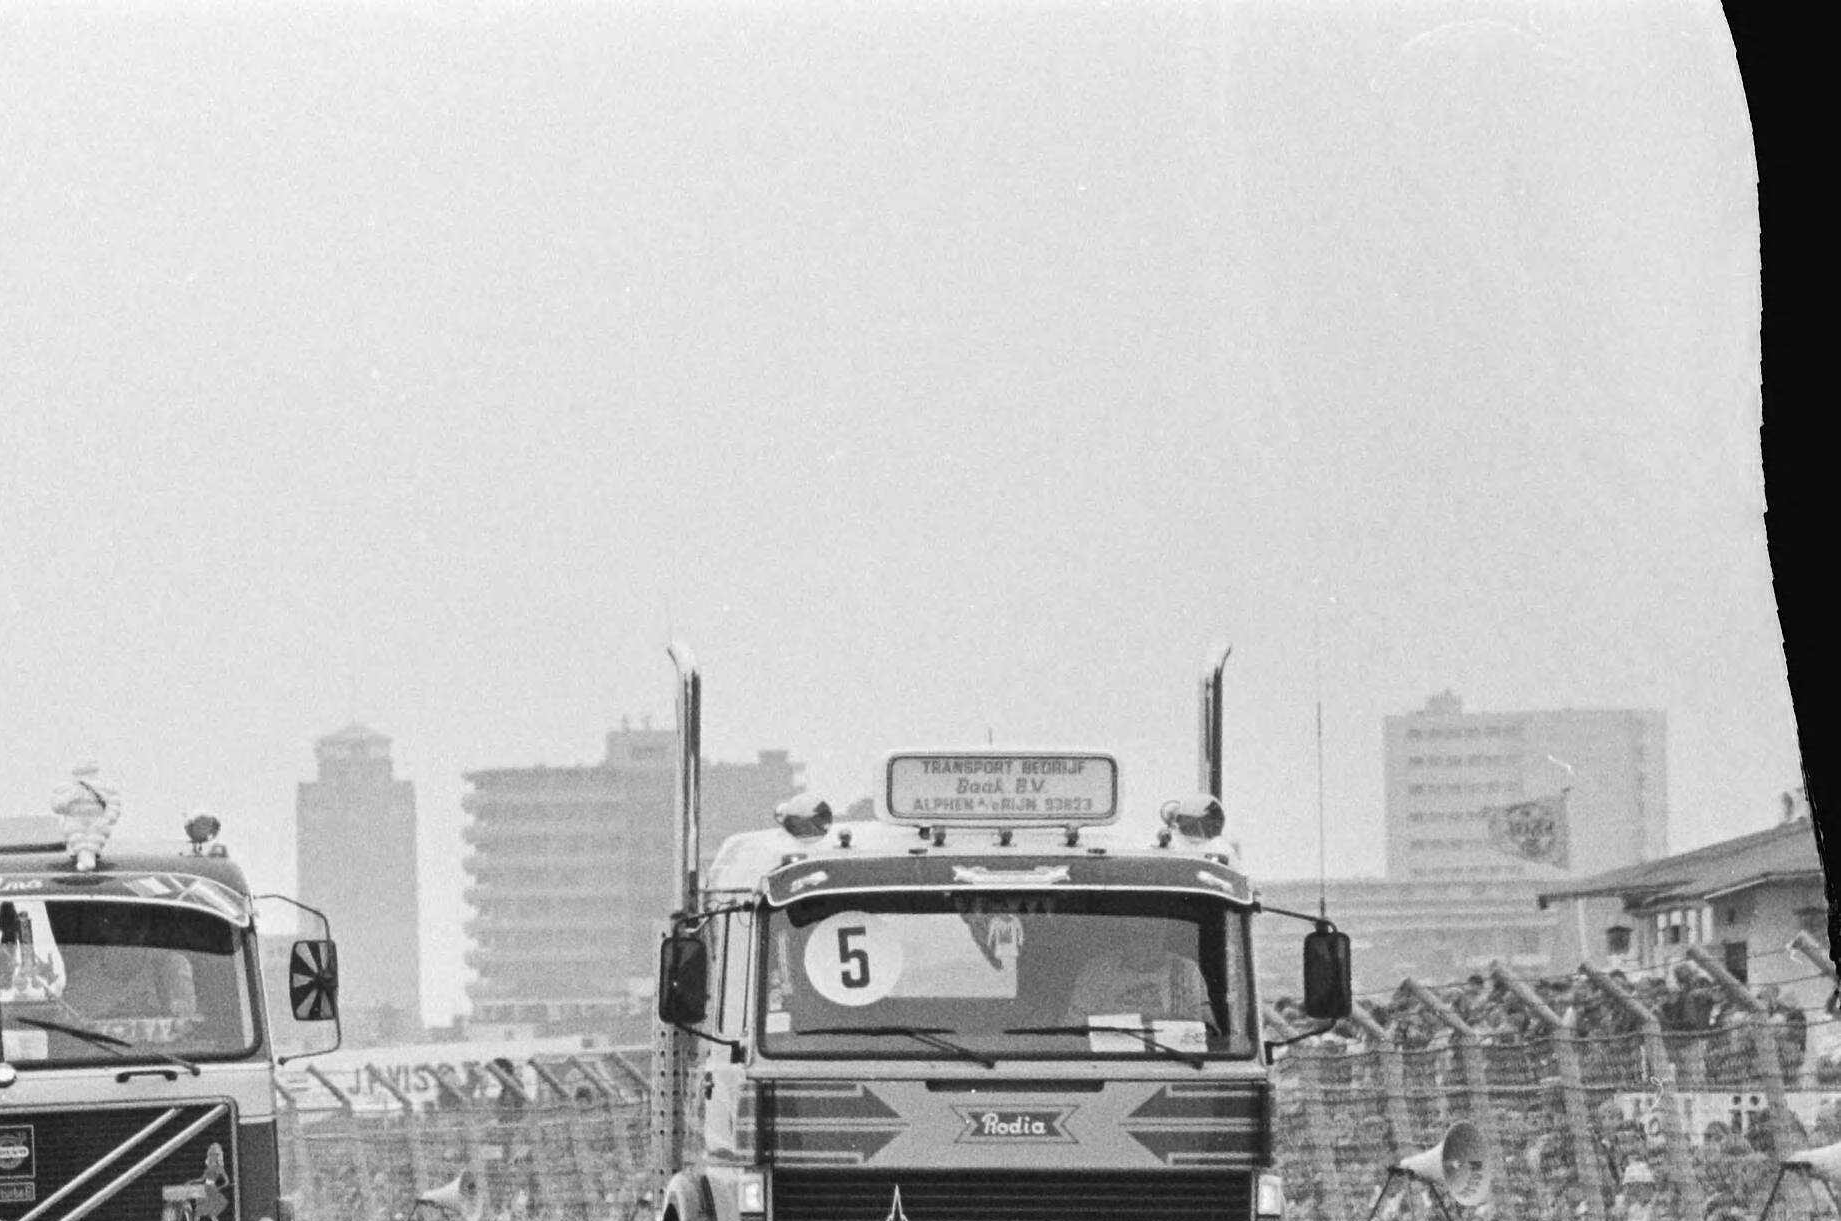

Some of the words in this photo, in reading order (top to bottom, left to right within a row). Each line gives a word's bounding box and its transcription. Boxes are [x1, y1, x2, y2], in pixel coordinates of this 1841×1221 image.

[922, 760, 1011, 775] TRANSPORT
[1022, 760, 1086, 775] BEDRIJF
[836, 926, 870, 989] 5
[981, 1113, 1047, 1135] Rodia
